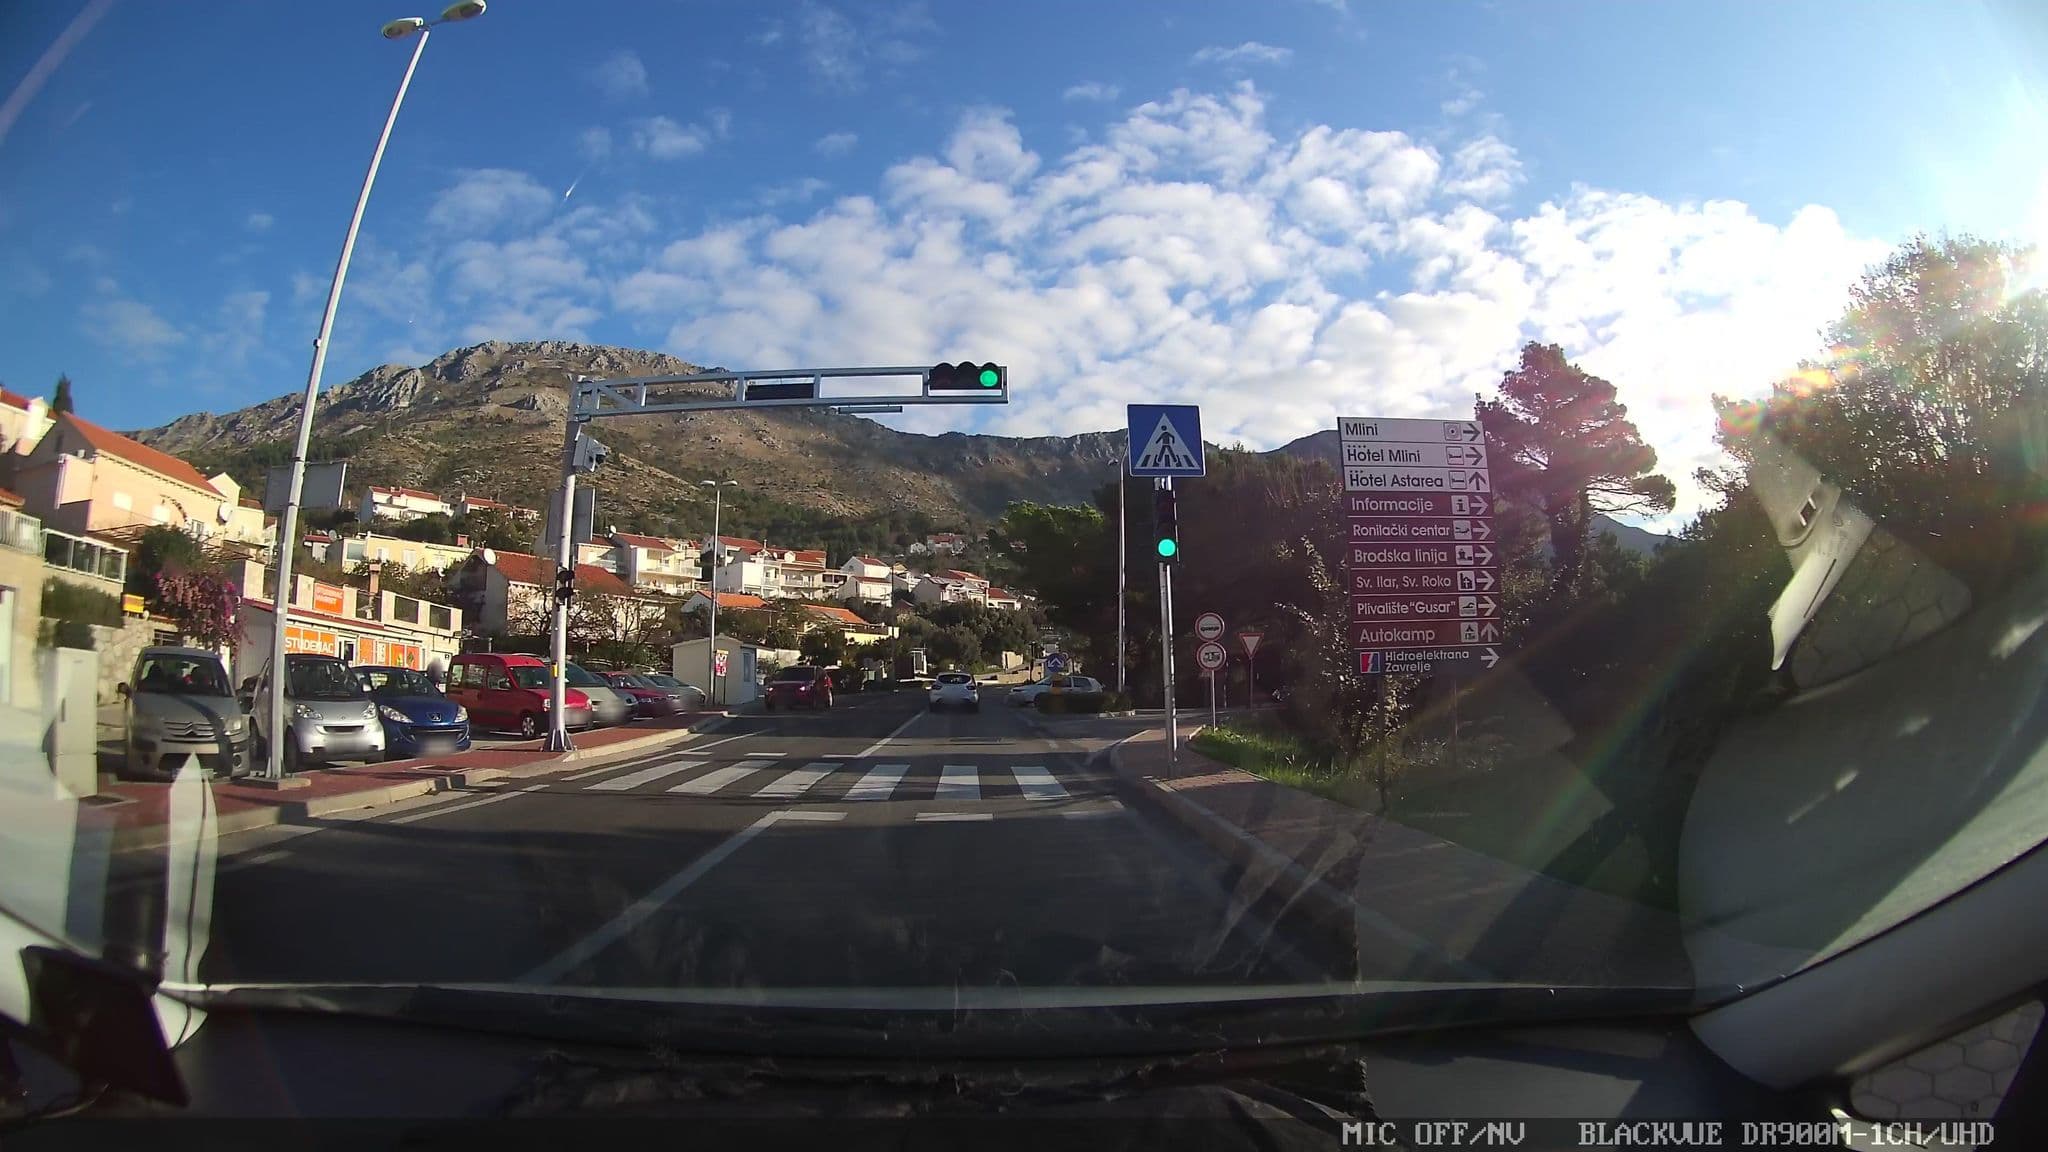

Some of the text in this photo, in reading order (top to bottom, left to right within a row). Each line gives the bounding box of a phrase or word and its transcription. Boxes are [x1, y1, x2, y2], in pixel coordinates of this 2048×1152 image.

[1345, 423, 1378, 436] Mlini
[1347, 448, 1421, 463] Hotel Mlini
[1349, 473, 1444, 488] Hotel Astarea
[1351, 497, 1434, 513] Informacije
[1353, 523, 1450, 536] Ronilački centar
[1354, 549, 1448, 564] Brodska linija
[1356, 575, 1452, 589] Sv. Ilar, Sv. Roko
[1357, 601, 1409, 615] Plivalište
[1360, 628, 1435, 643] Autokamp
[1385, 650, 1470, 661] Hidroelektrana
[1385, 662, 1431, 673] Zavrelje
